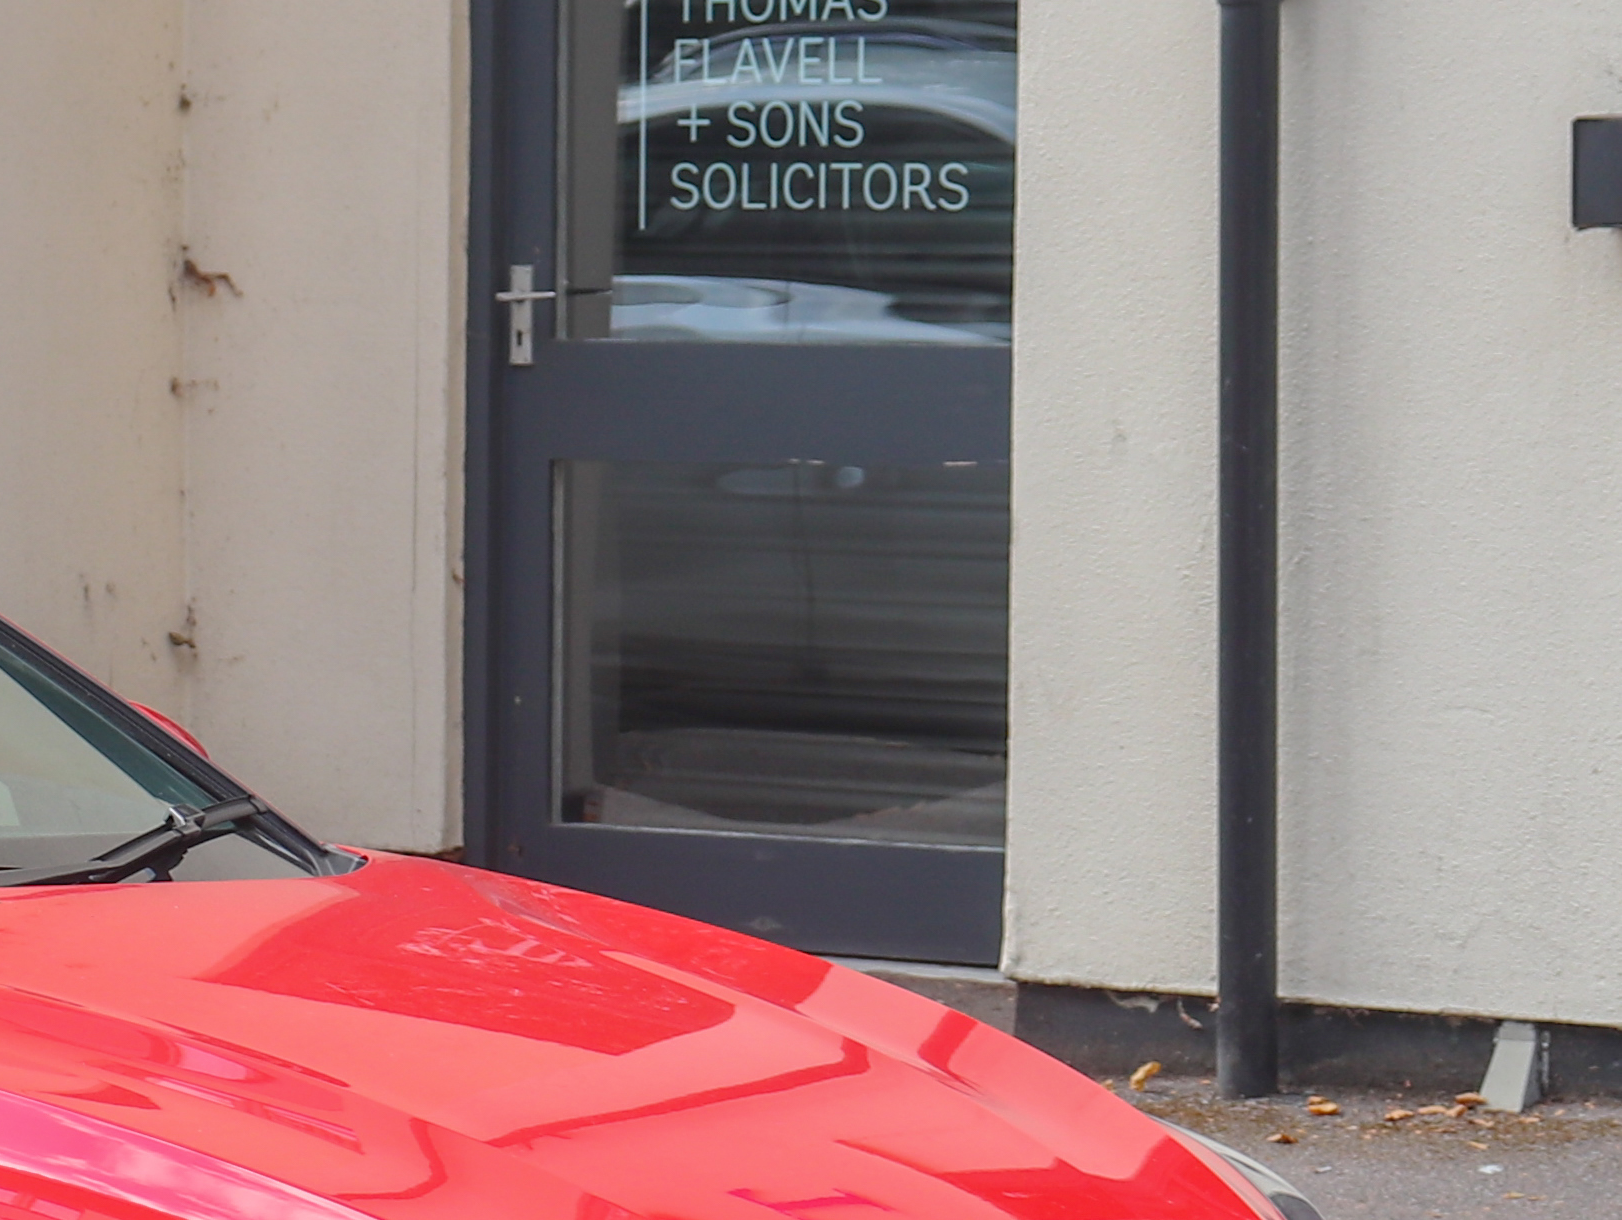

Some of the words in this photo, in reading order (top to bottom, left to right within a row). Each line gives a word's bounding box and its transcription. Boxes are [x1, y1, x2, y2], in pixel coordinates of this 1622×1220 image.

[673, 37, 883, 85] FLAVELL
[676, 103, 711, 143] +
[726, 99, 866, 149] SONS
[669, 161, 971, 213] SOLICITORS
